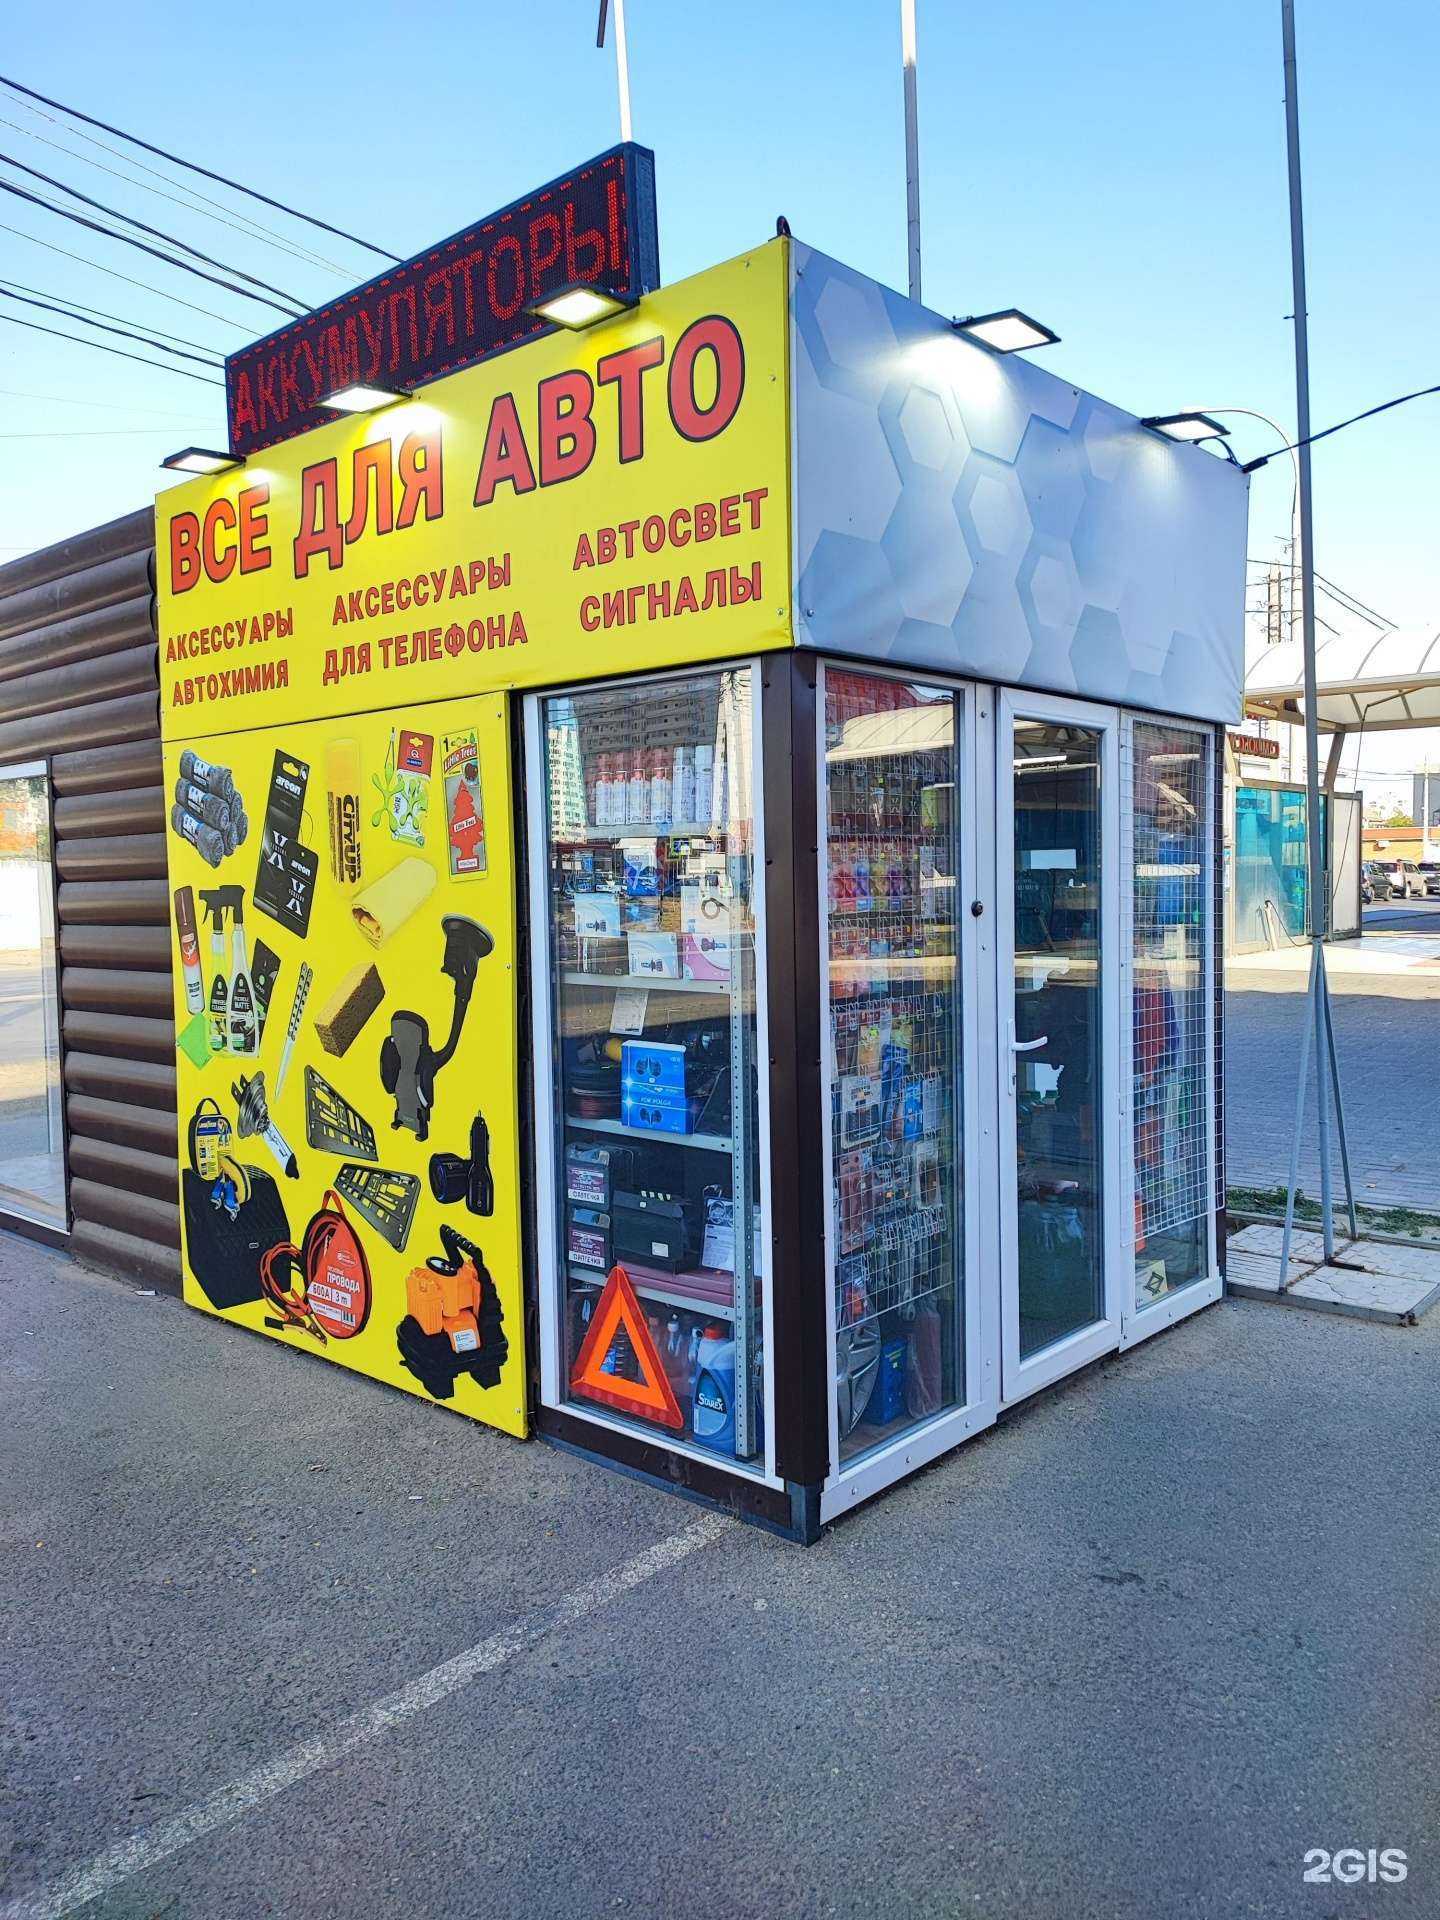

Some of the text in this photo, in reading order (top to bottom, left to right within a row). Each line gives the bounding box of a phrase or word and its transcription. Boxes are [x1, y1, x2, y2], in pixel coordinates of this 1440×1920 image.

[170, 315, 745, 595] ВСЕ ДЛЯ АВТО
[573, 487, 768, 570] АВТОСВЕТ
[332, 553, 511, 625] АКСЕССУАРЫ
[580, 561, 761, 632] СИГНАЛЫ
[166, 608, 293, 663] АКСЕССУАРЫ
[323, 611, 528, 686] ДЛЯ ТЕЛЕФОНА
[173, 659, 289, 706] АВТОХИМИЯ
[275, 775, 301, 796] areon
[291, 859, 311, 877] areon
[327, 1271, 360, 1293] ПРОВОДА
